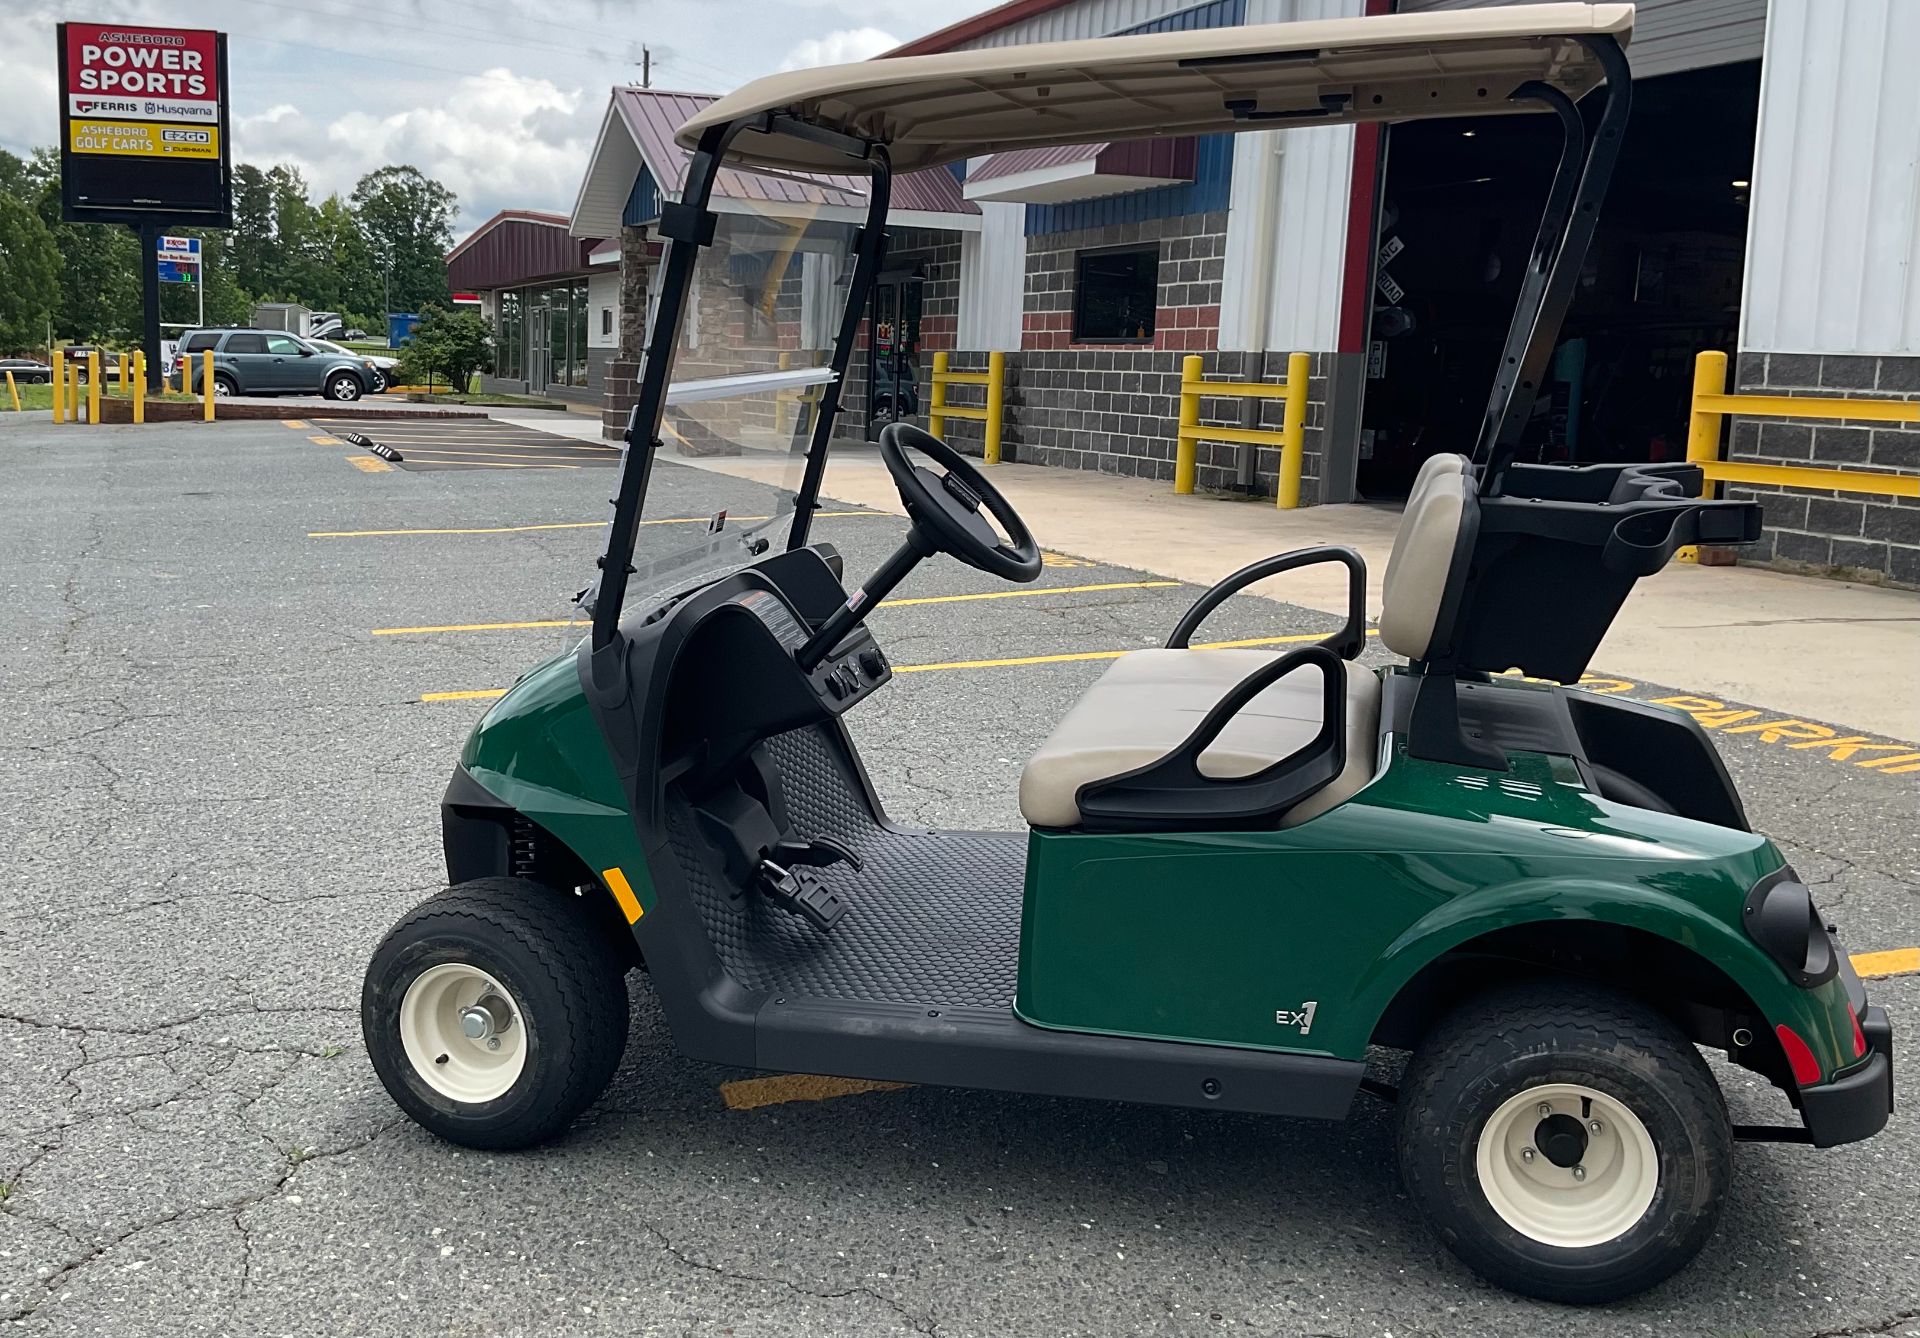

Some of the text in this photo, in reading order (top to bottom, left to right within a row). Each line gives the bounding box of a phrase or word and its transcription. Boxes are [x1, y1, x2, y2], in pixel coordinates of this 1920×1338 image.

[99, 32, 185, 46] ASHEBORO
[82, 44, 203, 72] POWER
[79, 68, 207, 95] SPORTS
[93, 101, 138, 112] FERRIS
[156, 104, 213, 116] Husqvarna
[81, 125, 148, 136] ASHEBORO
[76, 136, 154, 151] GOLF CARTS
[172, 146, 212, 154] CUSHMAN
